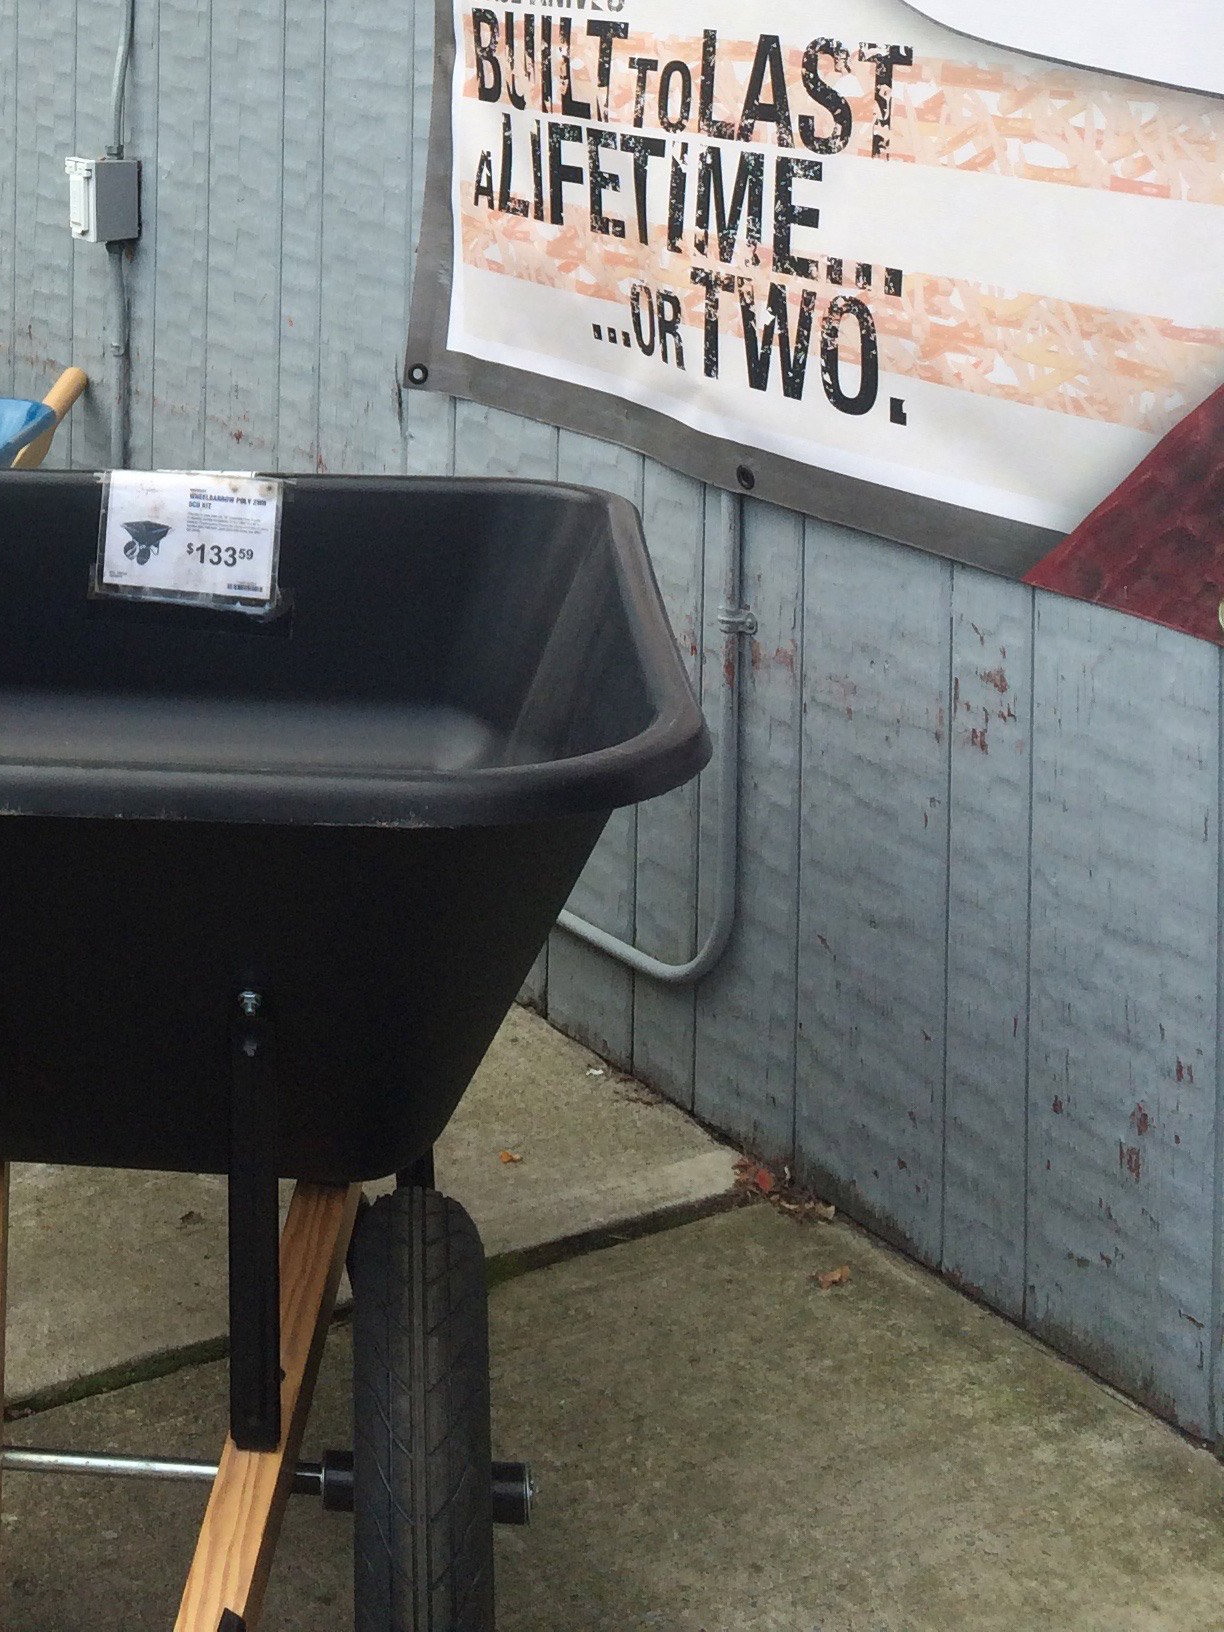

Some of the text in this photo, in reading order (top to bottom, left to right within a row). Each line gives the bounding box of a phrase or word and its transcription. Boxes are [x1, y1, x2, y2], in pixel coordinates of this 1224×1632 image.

[471, 8, 914, 162] BUILT TO LAST
[473, 147, 496, 212] A
[690, 265, 908, 426] TWO.
